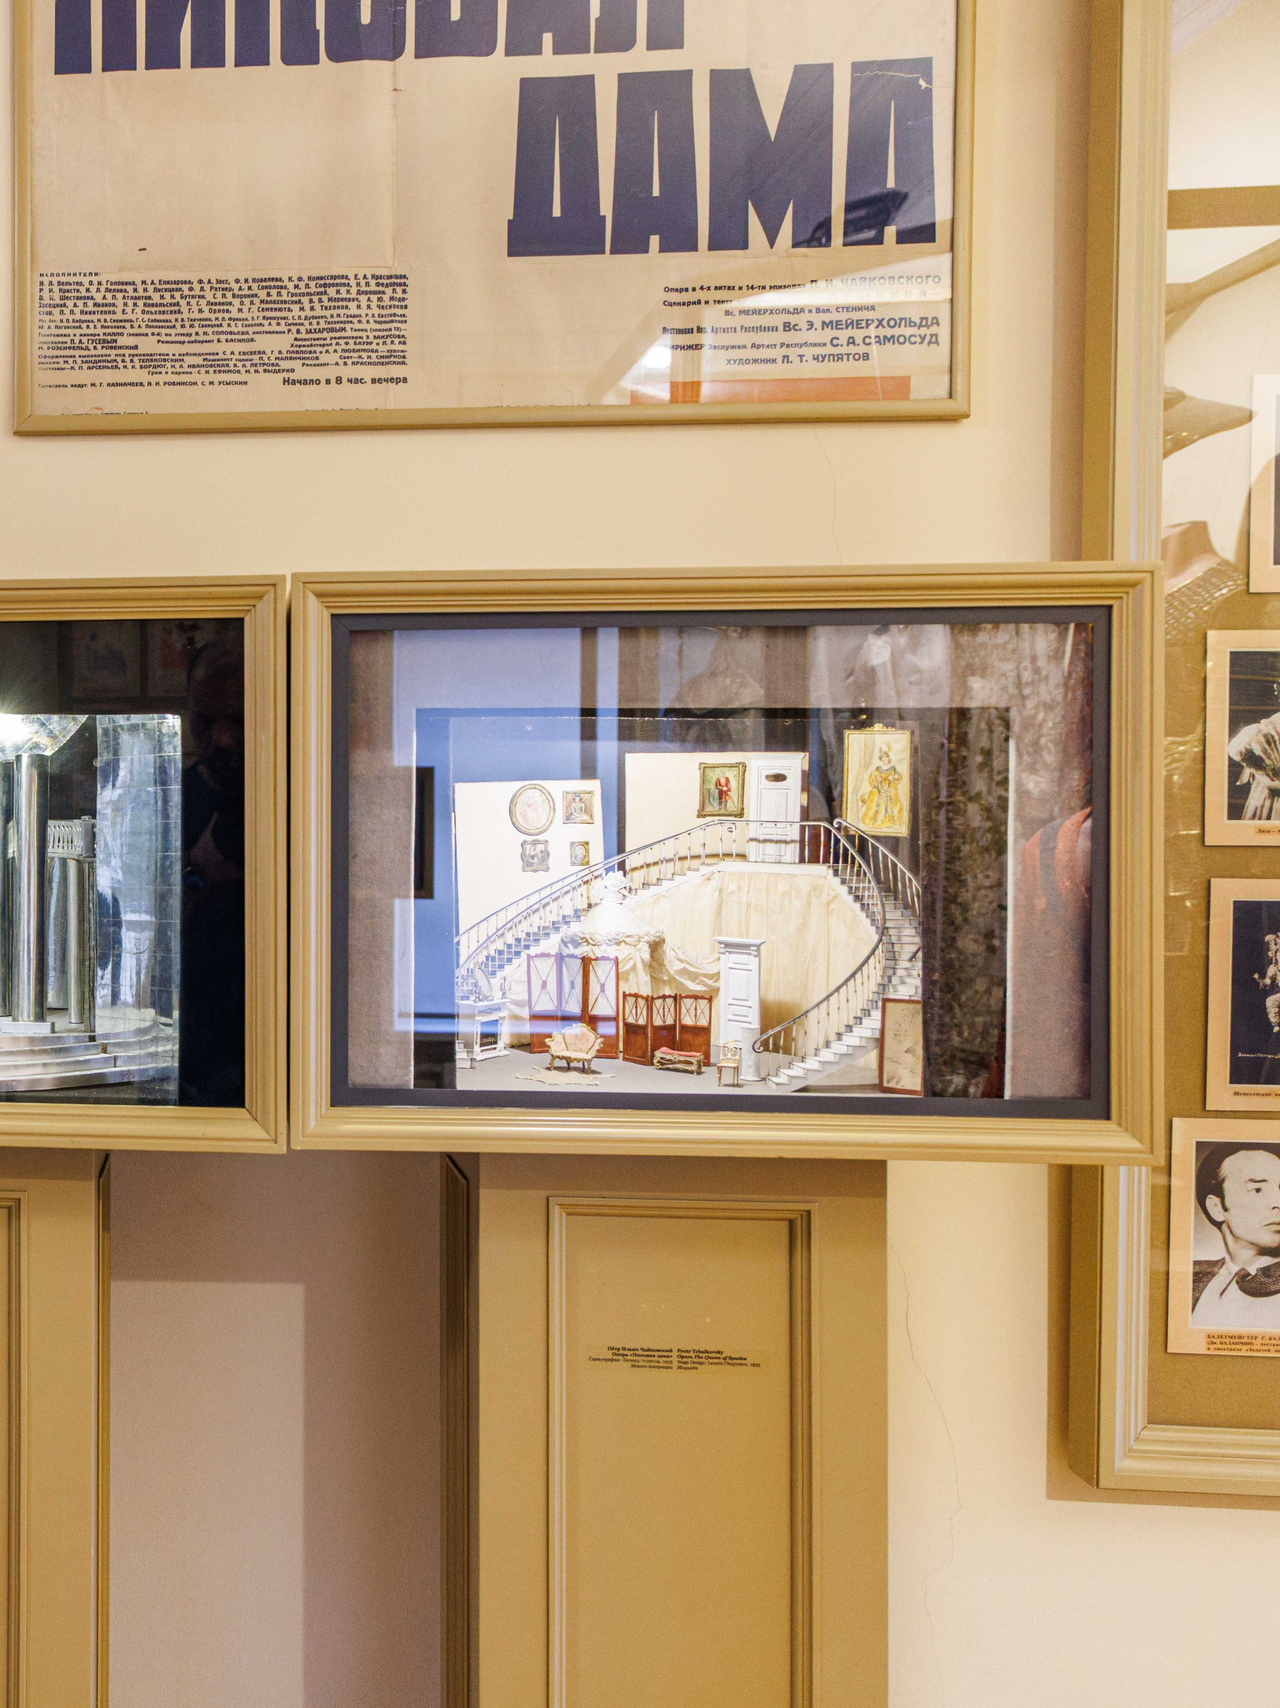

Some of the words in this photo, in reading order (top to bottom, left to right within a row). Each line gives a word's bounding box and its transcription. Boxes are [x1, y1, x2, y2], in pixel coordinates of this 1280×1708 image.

[507, 57, 936, 257] ДАМА
[841, 275, 941, 287] ЧАЙКОВСКОГО
[663, 299, 702, 307] Сценарий
[738, 307, 805, 316] МЕЙЕРХОЛЬДА
[836, 305, 876, 313] СТЕНИЧА
[783, 321, 802, 332] Вс.
[806, 320, 818, 331] Э.
[821, 316, 940, 331] МЕЙЕРХОЛЬДА
[666, 343, 705, 351] ИРИЖЕР
[780, 341, 827, 349] Республики
[830, 337, 843, 348] С.
[846, 336, 860, 347] А.
[862, 333, 940, 347] САМОСУД
[781, 355, 793, 364] Л.
[797, 354, 808, 363] Т.
[812, 352, 870, 363] ЧУПЯТОВ
[282, 377, 321, 386] Начало
[335, 376, 343, 385] 8
[347, 377, 367, 385] час.
[371, 377, 408, 385] вечера
